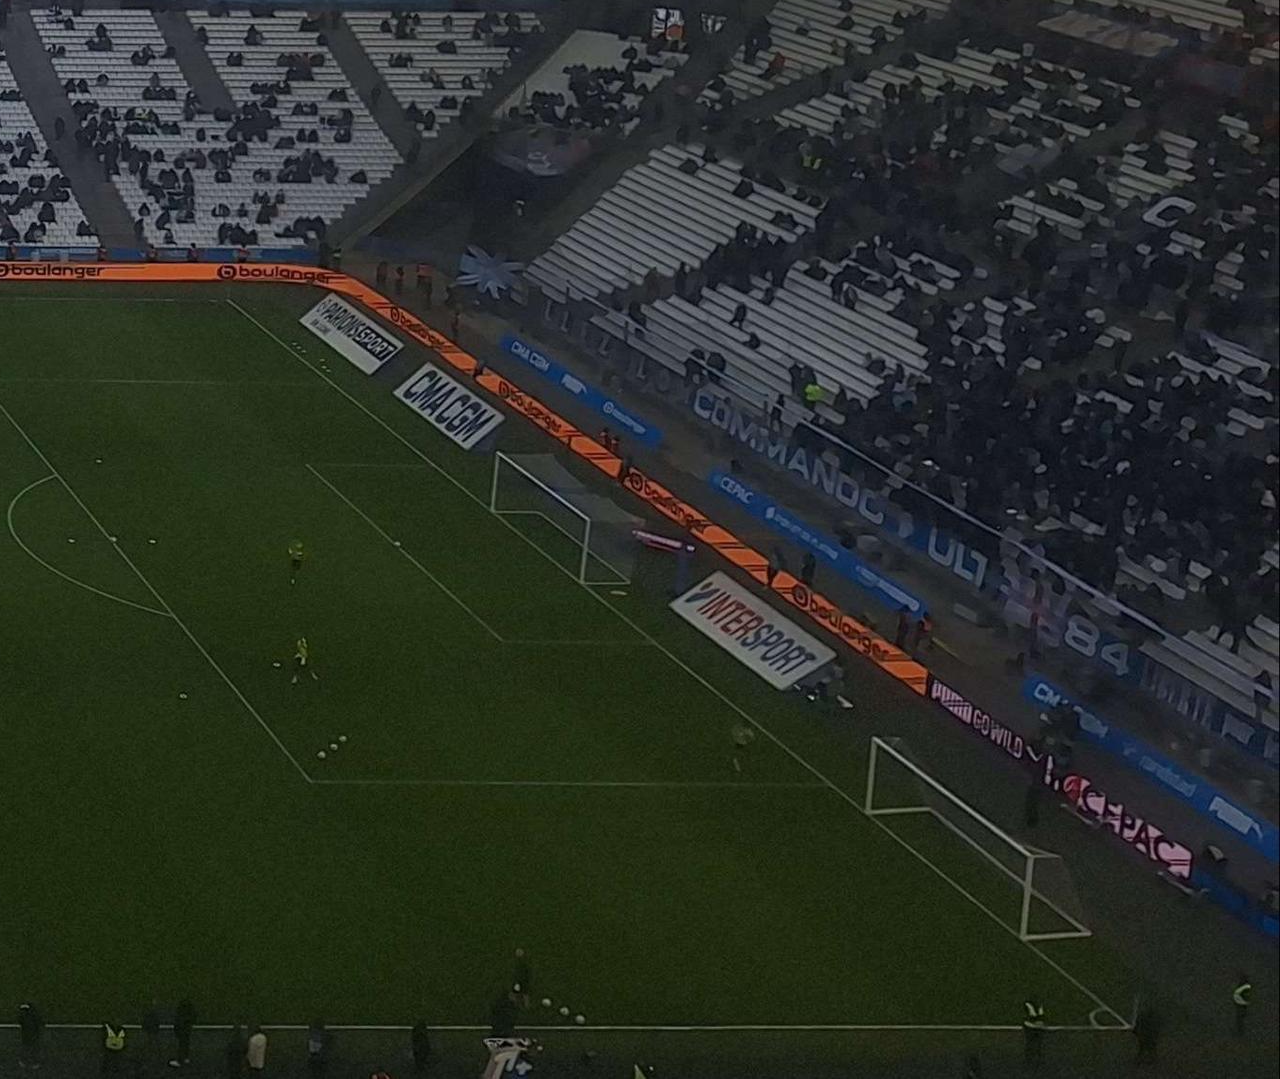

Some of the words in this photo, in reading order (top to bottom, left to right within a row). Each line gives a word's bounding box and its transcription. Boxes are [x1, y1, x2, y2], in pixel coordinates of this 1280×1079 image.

[13, 263, 105, 277] boulanger
[403, 370, 448, 424] CMA
[434, 392, 495, 446] CGM
[720, 477, 755, 504] CEPAC
[697, 591, 817, 677] INTERSPORT
[990, 719, 1025, 760] WILD
